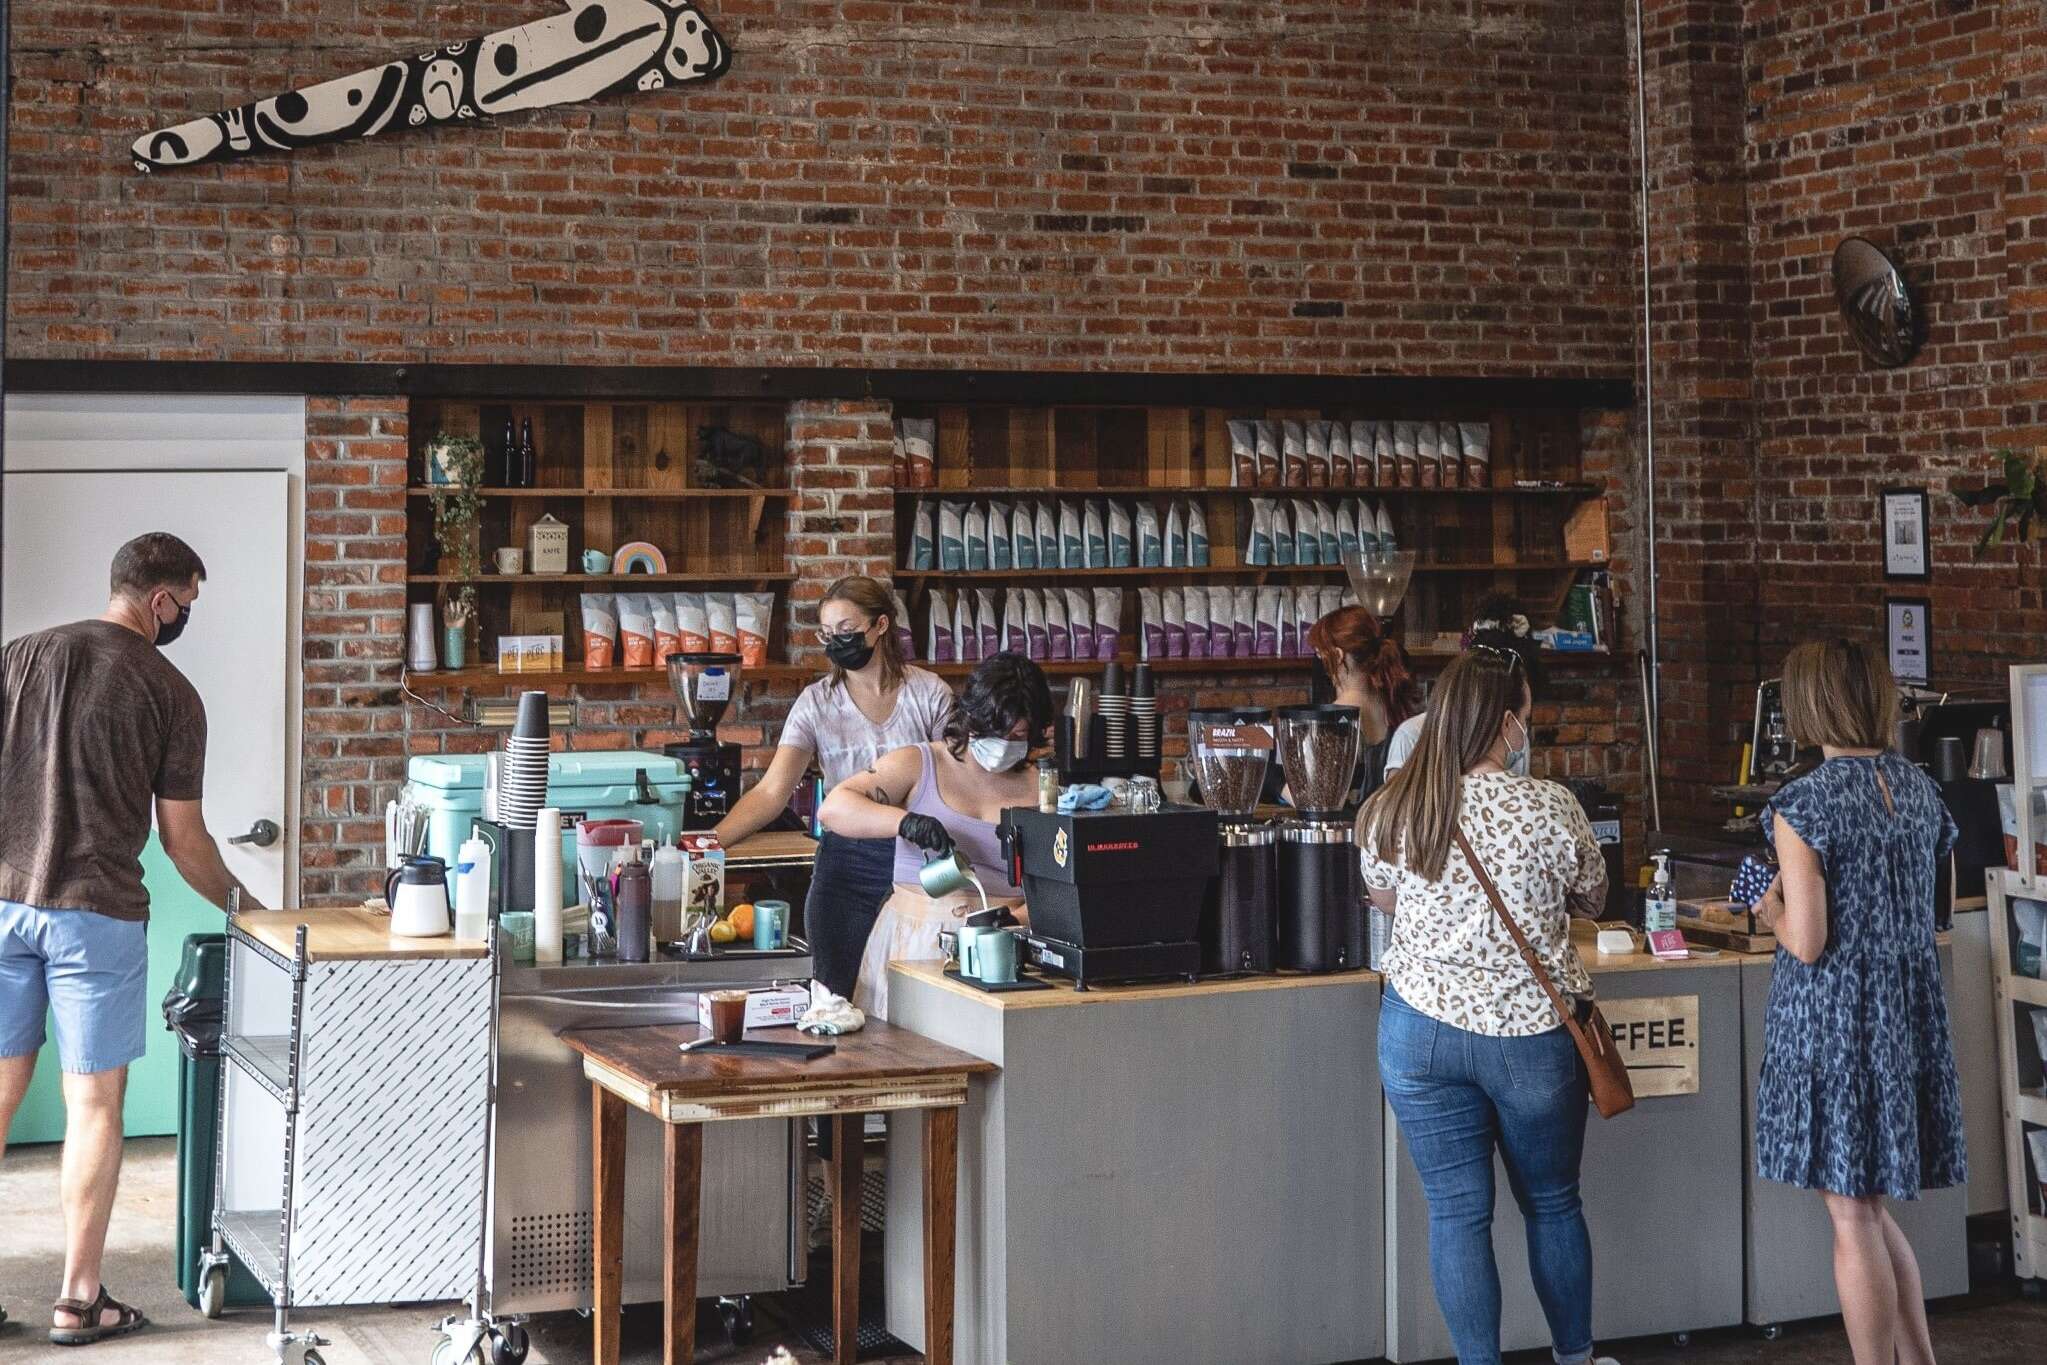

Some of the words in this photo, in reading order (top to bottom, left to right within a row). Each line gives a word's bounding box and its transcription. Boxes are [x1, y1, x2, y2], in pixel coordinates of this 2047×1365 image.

[1212, 728, 1236, 737] BRAZIL
[692, 862, 721, 873] ORGANIC
[695, 867, 717, 876] VALLEY
[1611, 1018, 1694, 1050] FFEE.
